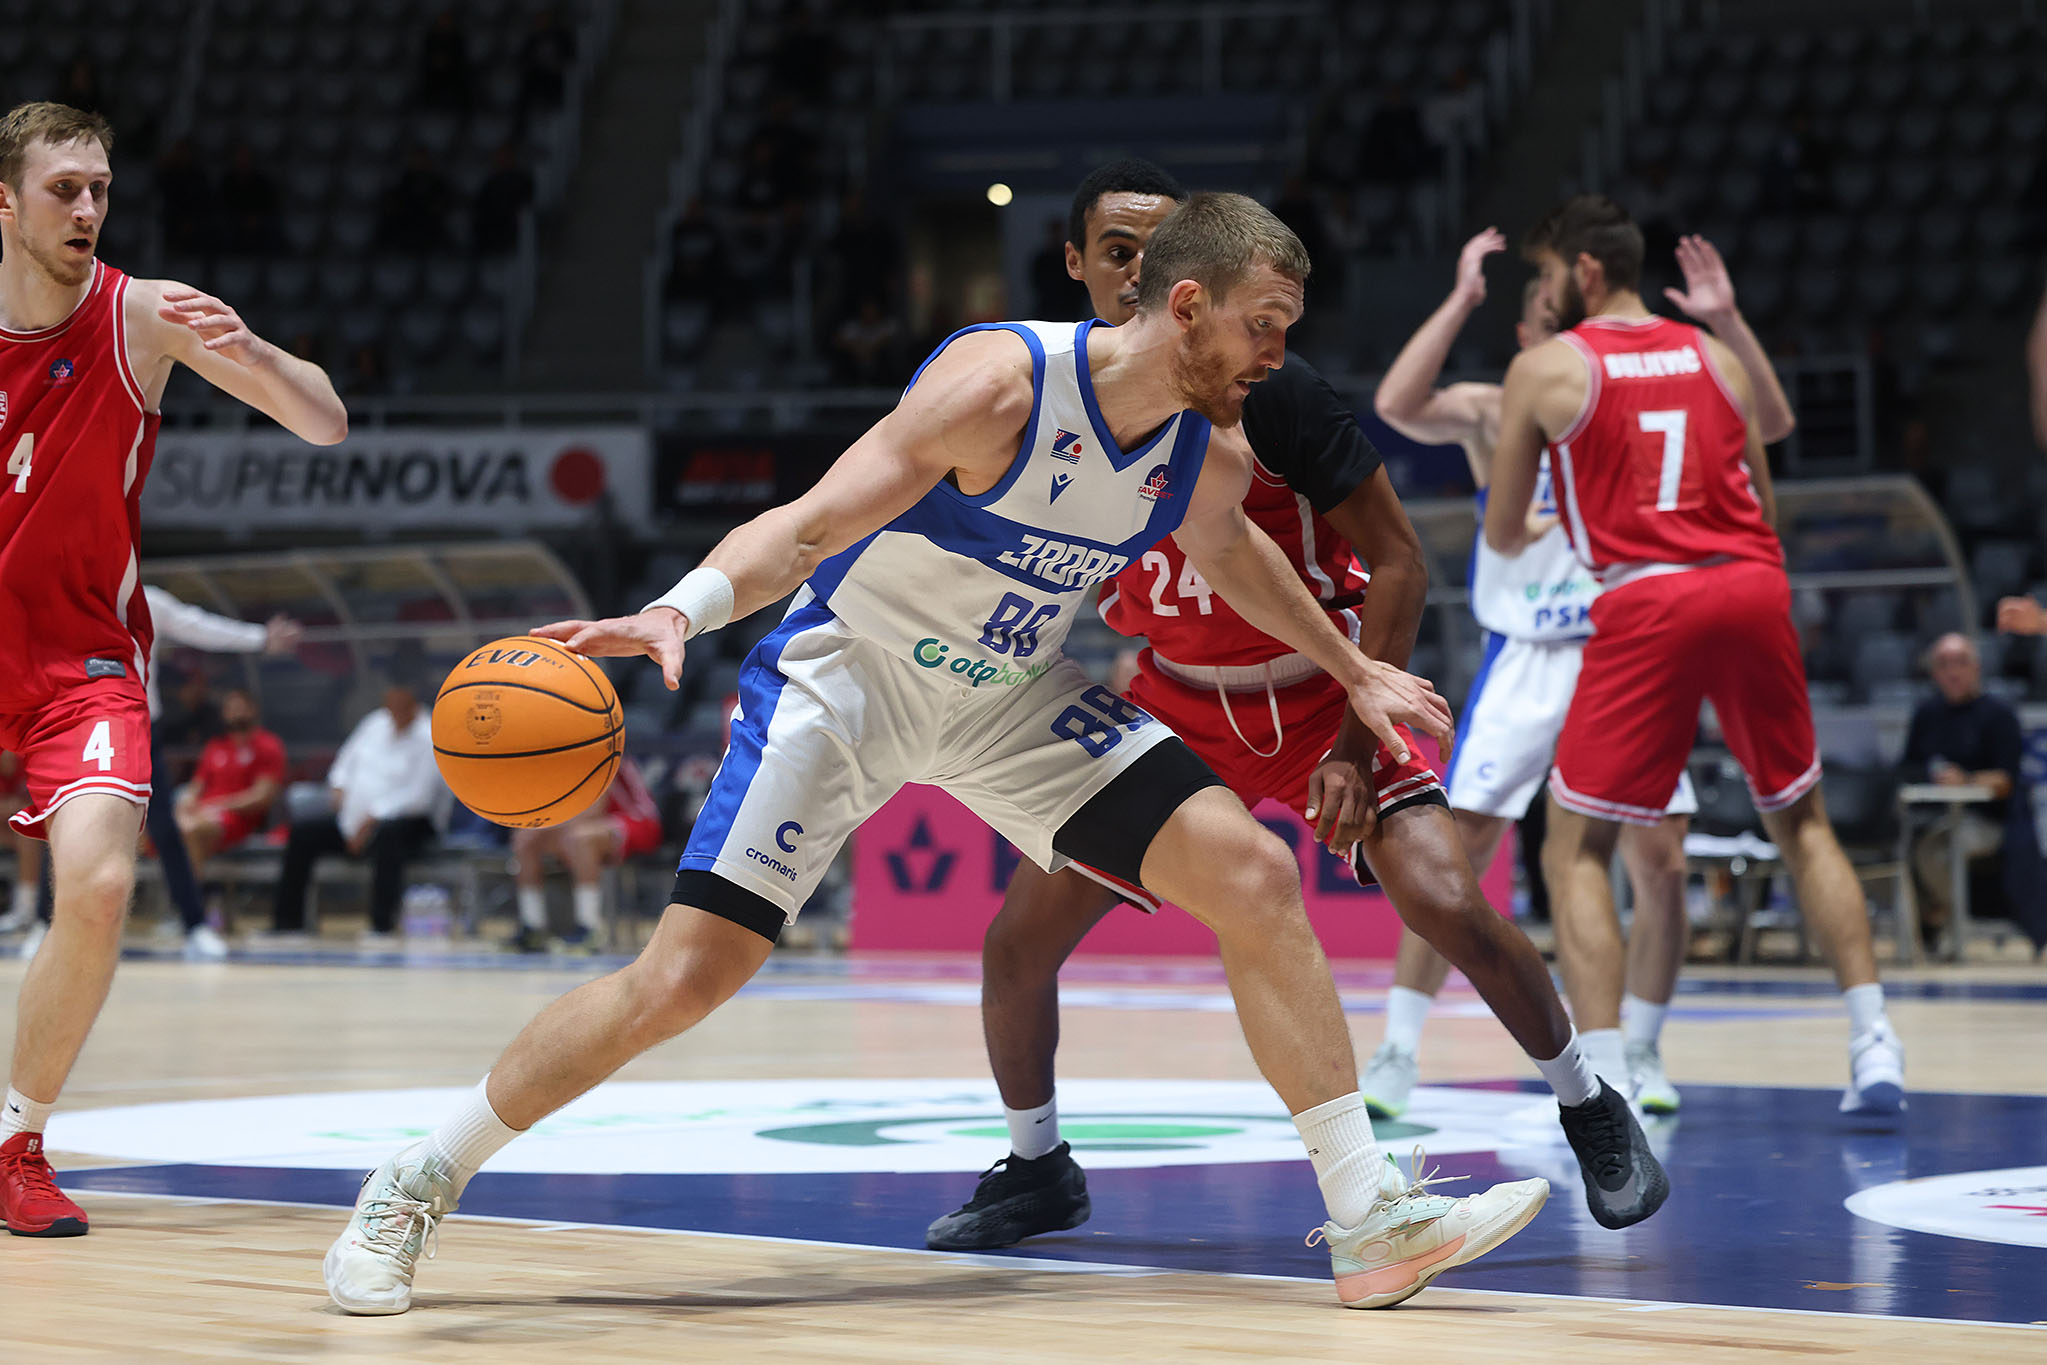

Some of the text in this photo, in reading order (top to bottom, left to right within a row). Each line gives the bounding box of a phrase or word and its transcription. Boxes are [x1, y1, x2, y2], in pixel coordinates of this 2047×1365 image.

[7, 432, 35, 494] 4
[158, 448, 530, 507] SUPERNOVA
[1637, 410, 1688, 512] 7
[1142, 551, 1214, 616] 24
[466, 649, 541, 669] EVO
[82, 720, 115, 771] 4
[745, 847, 797, 881] cromaris
